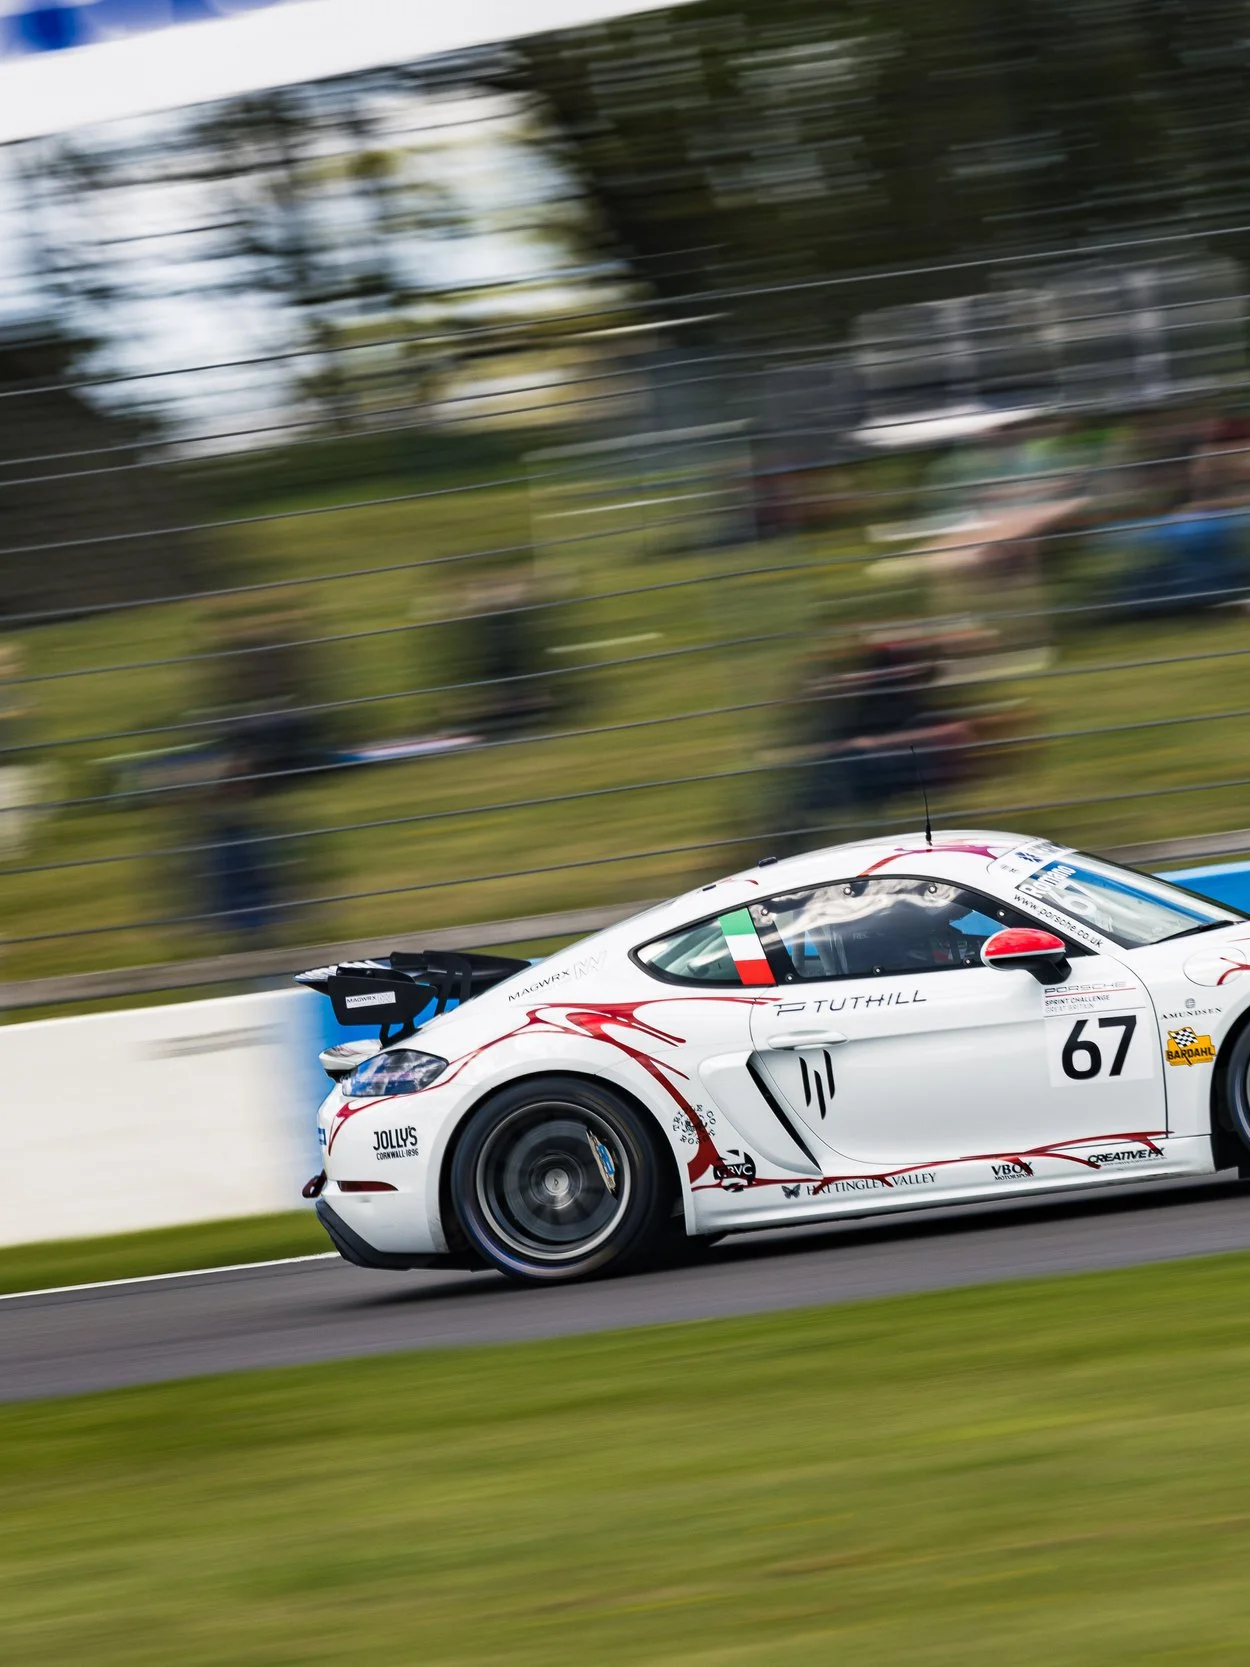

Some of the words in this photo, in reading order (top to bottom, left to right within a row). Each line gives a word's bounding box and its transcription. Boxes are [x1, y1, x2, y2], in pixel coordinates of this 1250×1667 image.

[1014, 894, 1103, 948] www.porsche.co.uk
[508, 970, 571, 1002] MAGWRX
[1044, 982, 1126, 994] PORSCHE
[814, 990, 927, 1013] TUTHILL
[1070, 994, 1110, 1004] CHALLENGE
[1161, 1007, 1222, 1019] AMUNDSEN
[1062, 1015, 1137, 1080] 67
[1166, 1047, 1217, 1060] BARDAHL
[373, 1125, 418, 1151] JOLLY'S
[1088, 1149, 1147, 1164] CREATIVE
[892, 1172, 937, 1186] VALLEY
